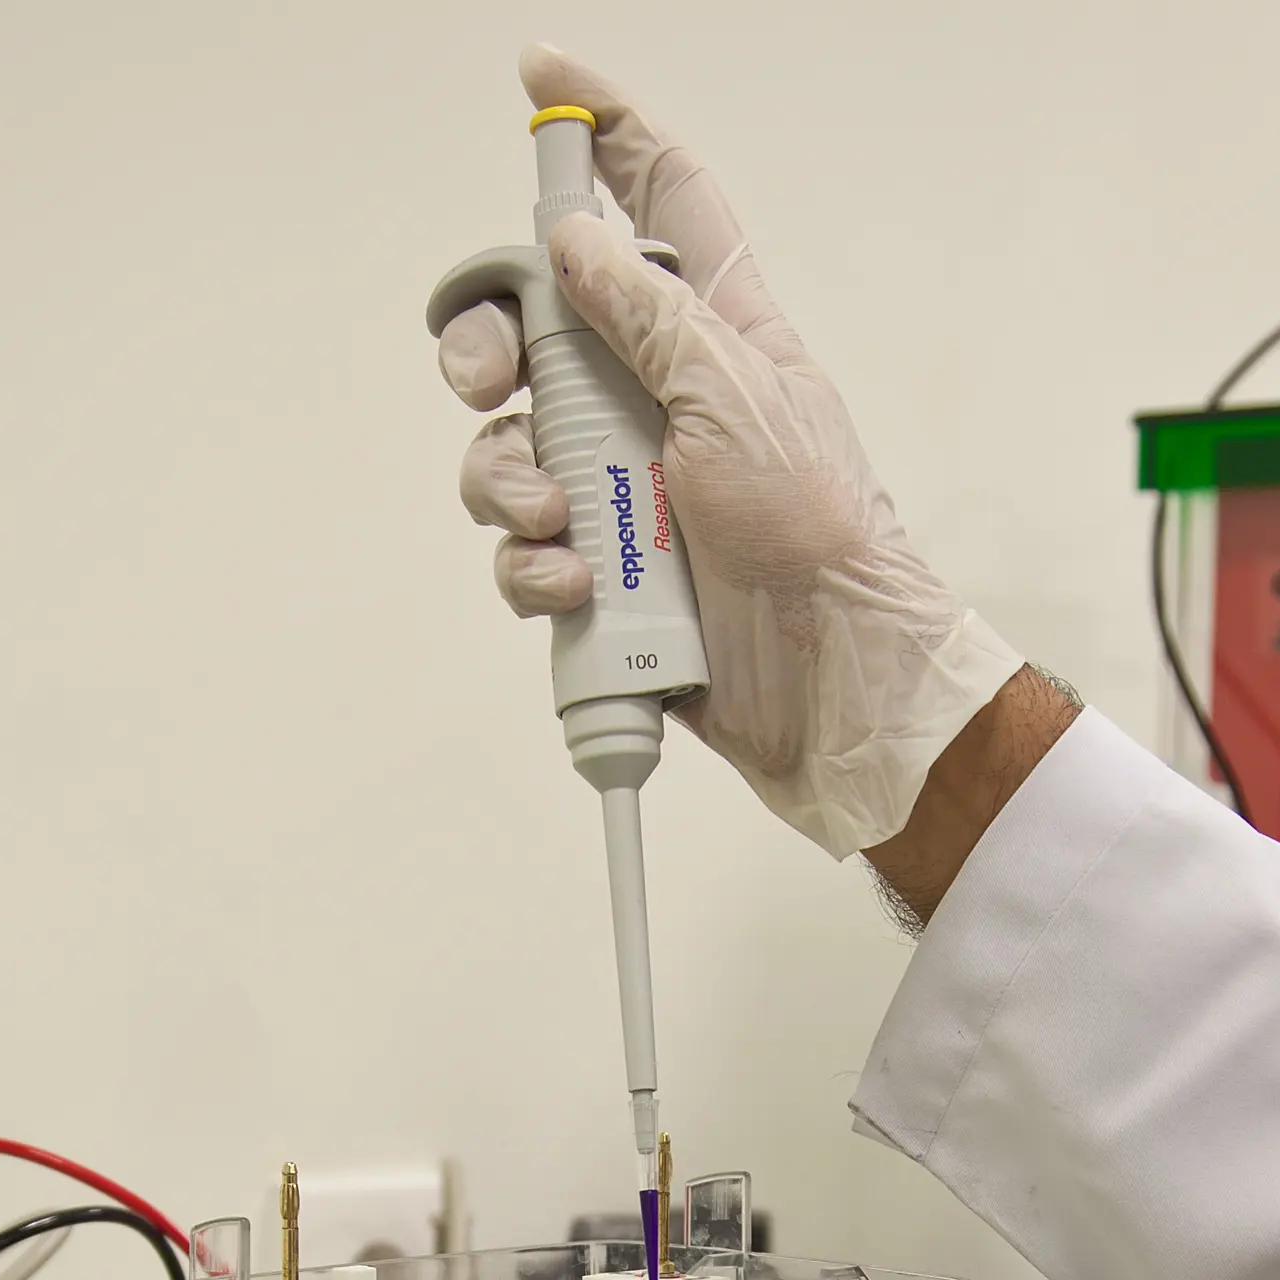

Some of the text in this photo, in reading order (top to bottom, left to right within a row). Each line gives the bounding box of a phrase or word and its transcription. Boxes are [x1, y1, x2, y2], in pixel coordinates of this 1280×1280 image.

[606, 464, 645, 590] eppendorf
[647, 461, 672, 553] Research
[624, 653, 658, 670] 100
